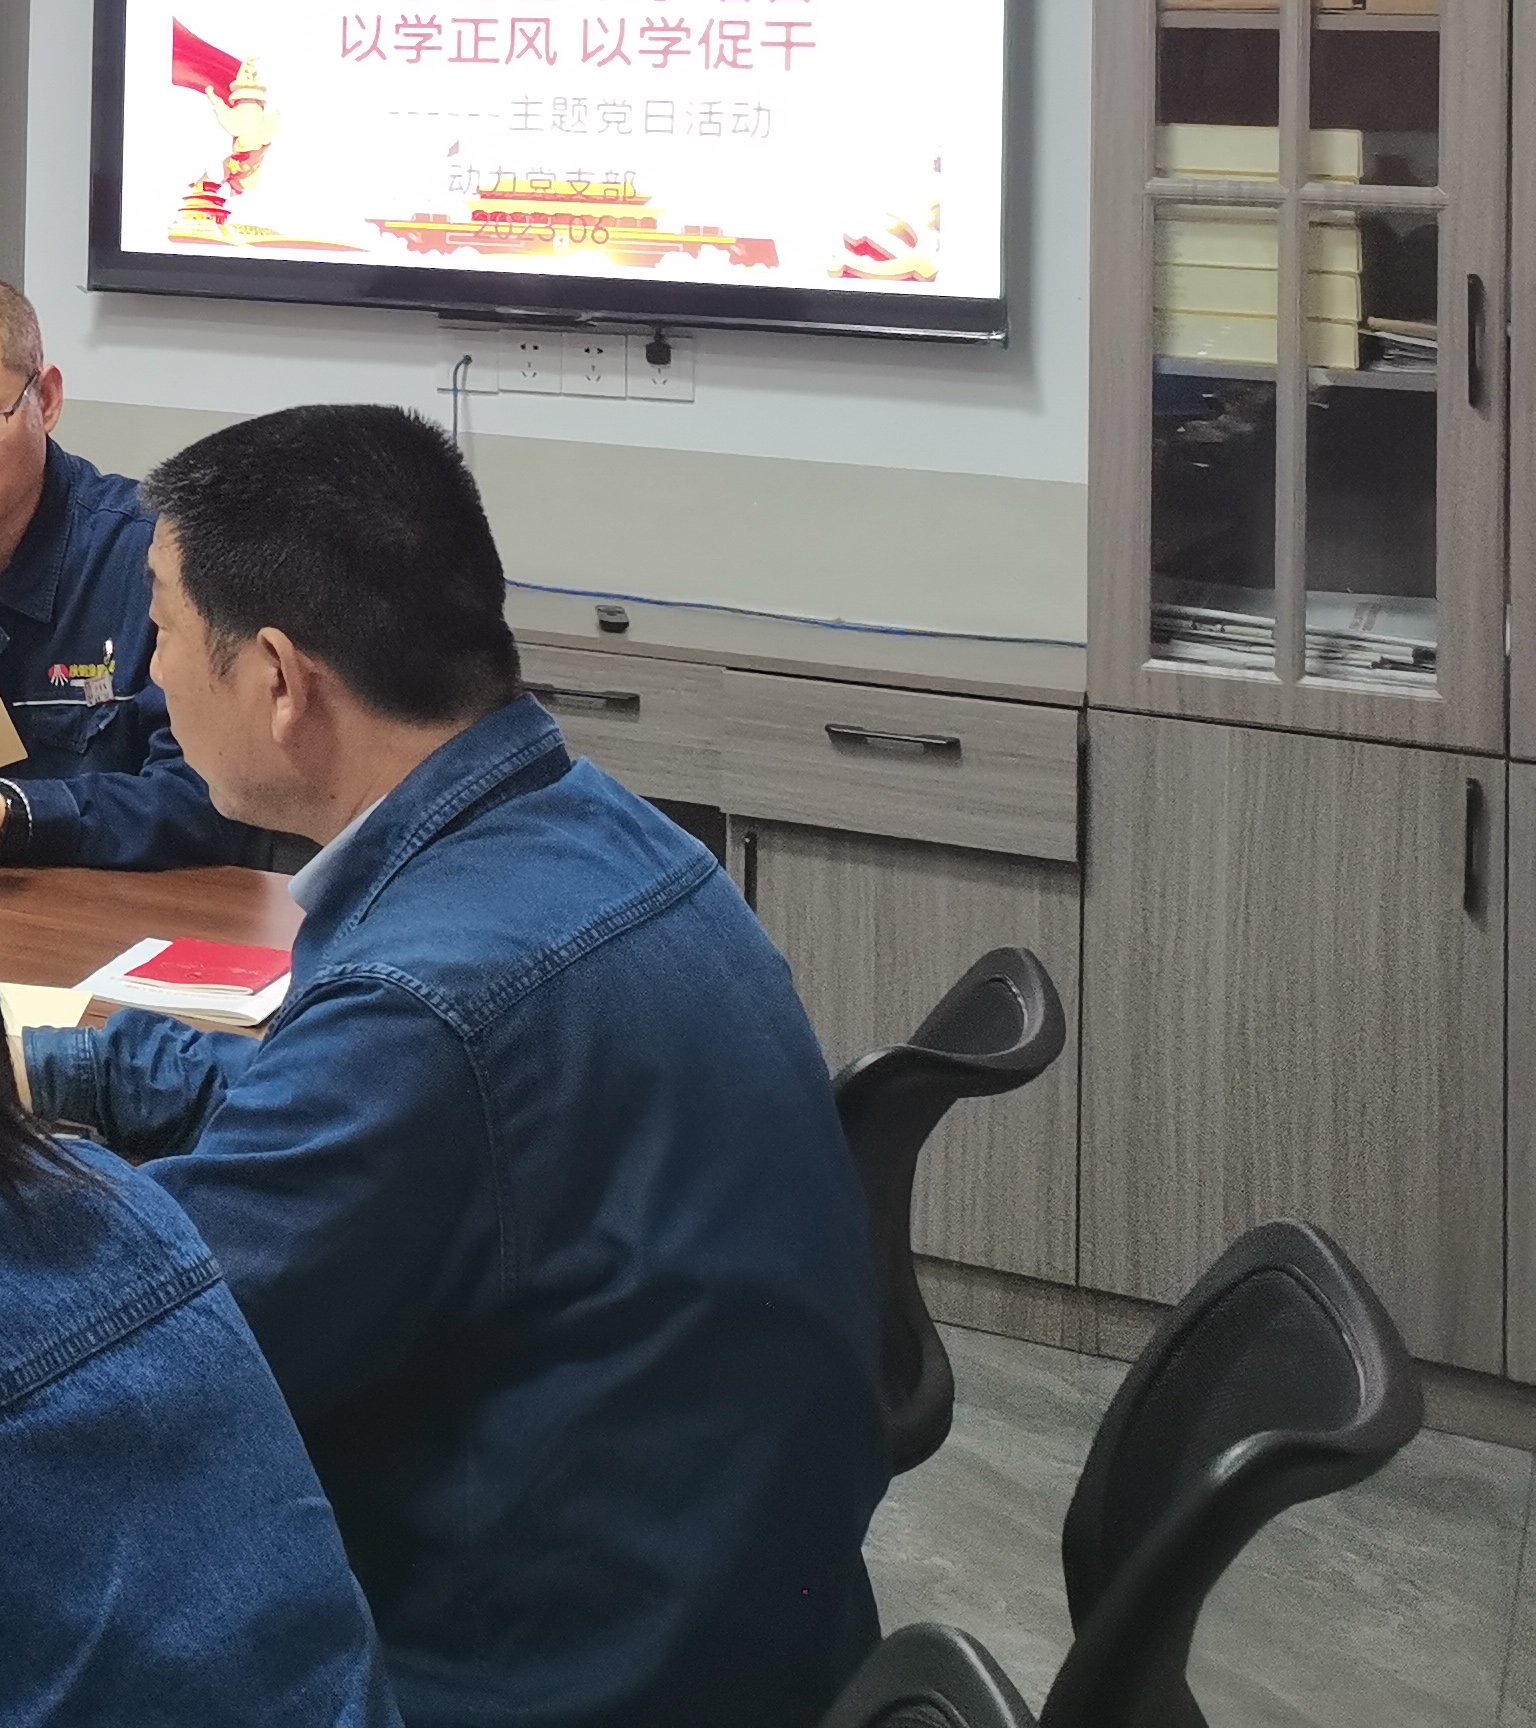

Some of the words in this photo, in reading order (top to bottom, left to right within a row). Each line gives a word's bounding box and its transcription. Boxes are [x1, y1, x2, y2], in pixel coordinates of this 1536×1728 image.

[338, 12, 559, 68] 以学正风
[581, 14, 818, 72] 以学促干
[447, 163, 638, 200] 动力党支部
